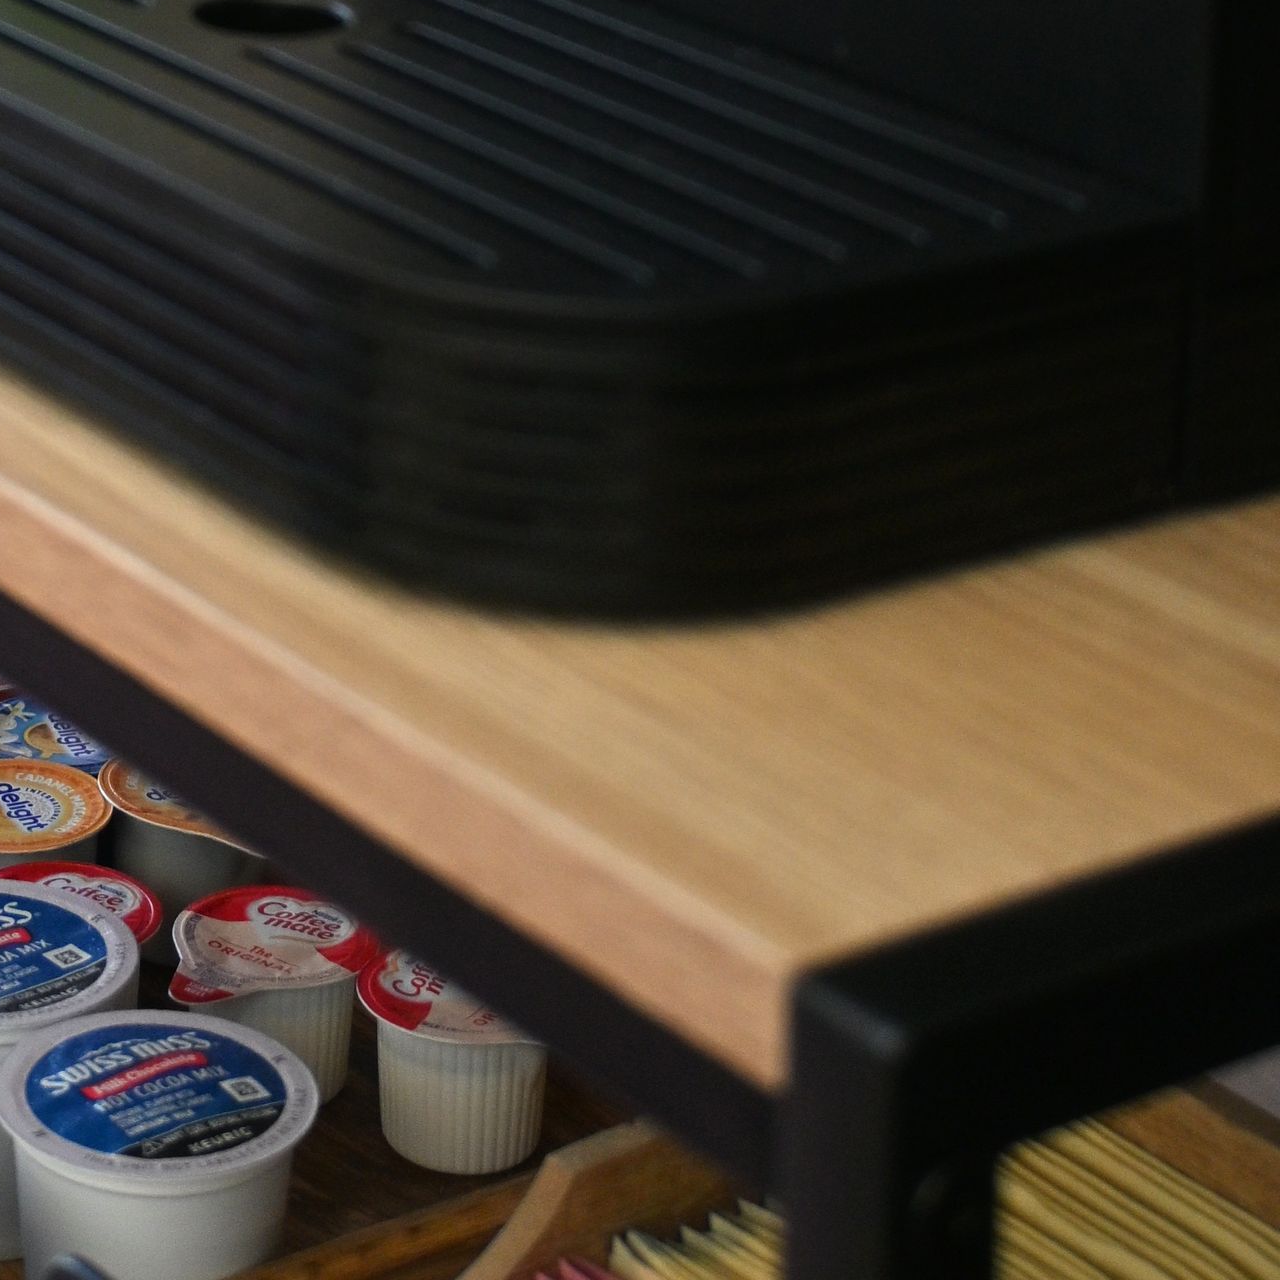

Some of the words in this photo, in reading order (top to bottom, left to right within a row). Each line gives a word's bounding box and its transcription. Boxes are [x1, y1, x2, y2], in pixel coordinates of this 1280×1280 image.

[16, 772, 74, 796] CARAMEL
[257, 901, 341, 932] Coffee
[264, 917, 335, 940] mate
[20, 938, 52, 956] MIX
[208, 940, 293, 974] ORIGINAL
[249, 945, 273, 959] The
[392, 963, 433, 997] Coff
[93, 1093, 133, 1113] HOT
[133, 1074, 192, 1098] COCOA
[194, 1065, 231, 1082] MIX
[187, 1125, 253, 1155] KEURIG
